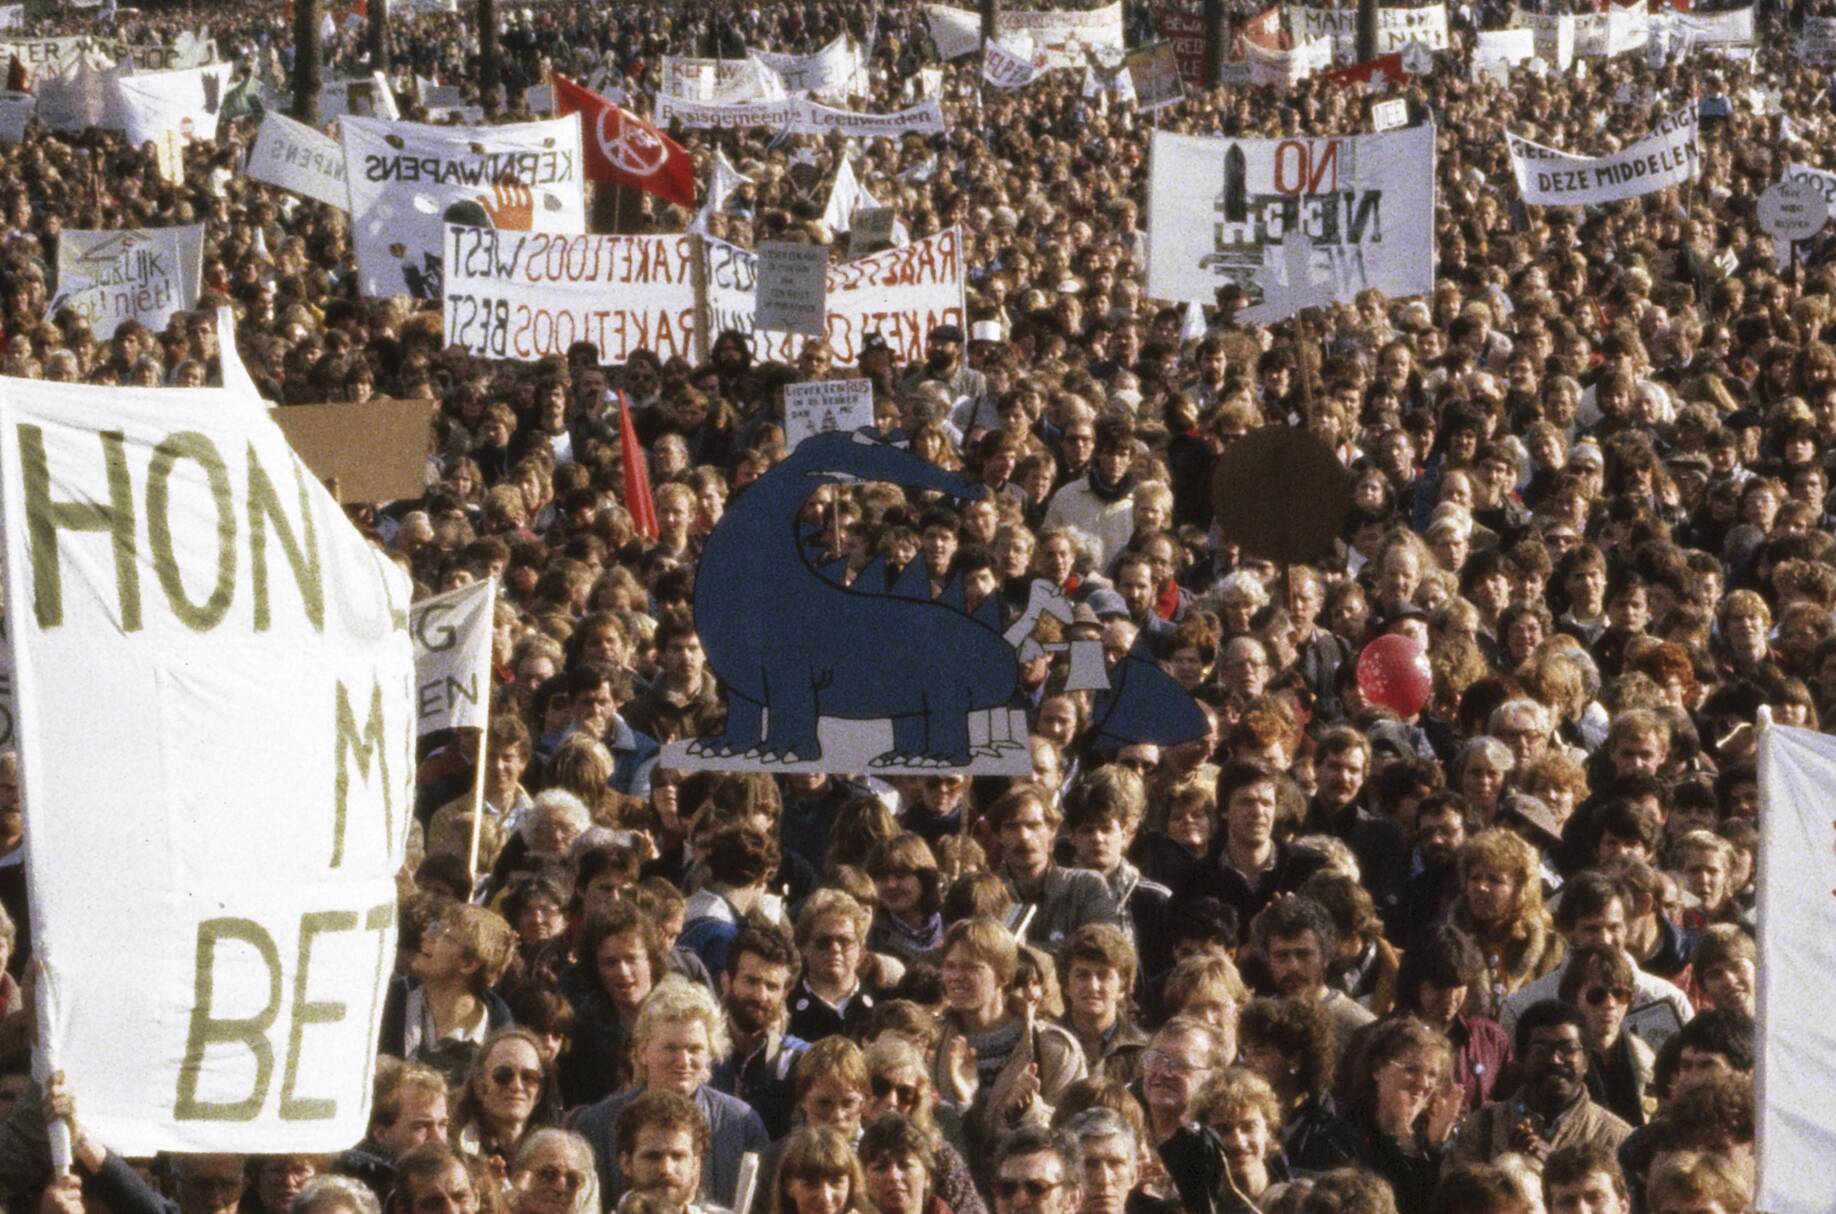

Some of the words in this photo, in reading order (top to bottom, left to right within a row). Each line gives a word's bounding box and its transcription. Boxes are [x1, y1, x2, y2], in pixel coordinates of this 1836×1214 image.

[812, 109, 932, 129] Leeuwarden
[1538, 170, 1589, 192] DEZE
[1595, 140, 1698, 187] MIDDELEN
